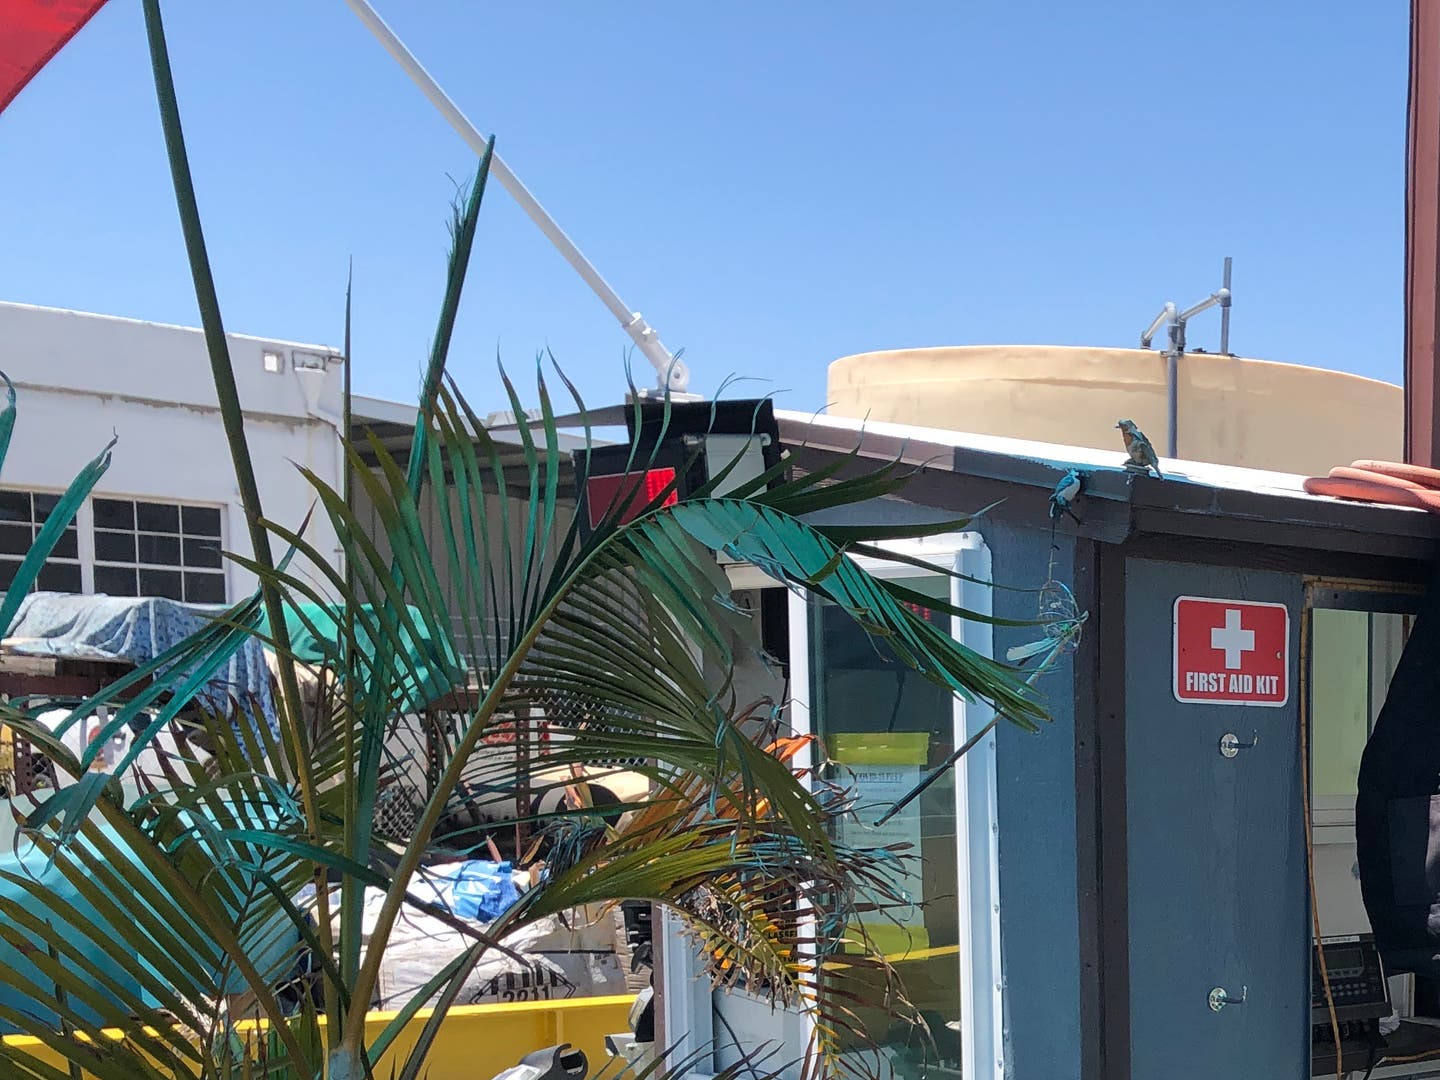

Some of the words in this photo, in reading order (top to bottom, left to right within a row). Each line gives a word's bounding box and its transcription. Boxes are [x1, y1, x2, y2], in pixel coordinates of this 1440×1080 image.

[1186, 671, 1226, 693] FIRST
[1228, 673, 1253, 694] AID
[1256, 675, 1279, 695] KIT
